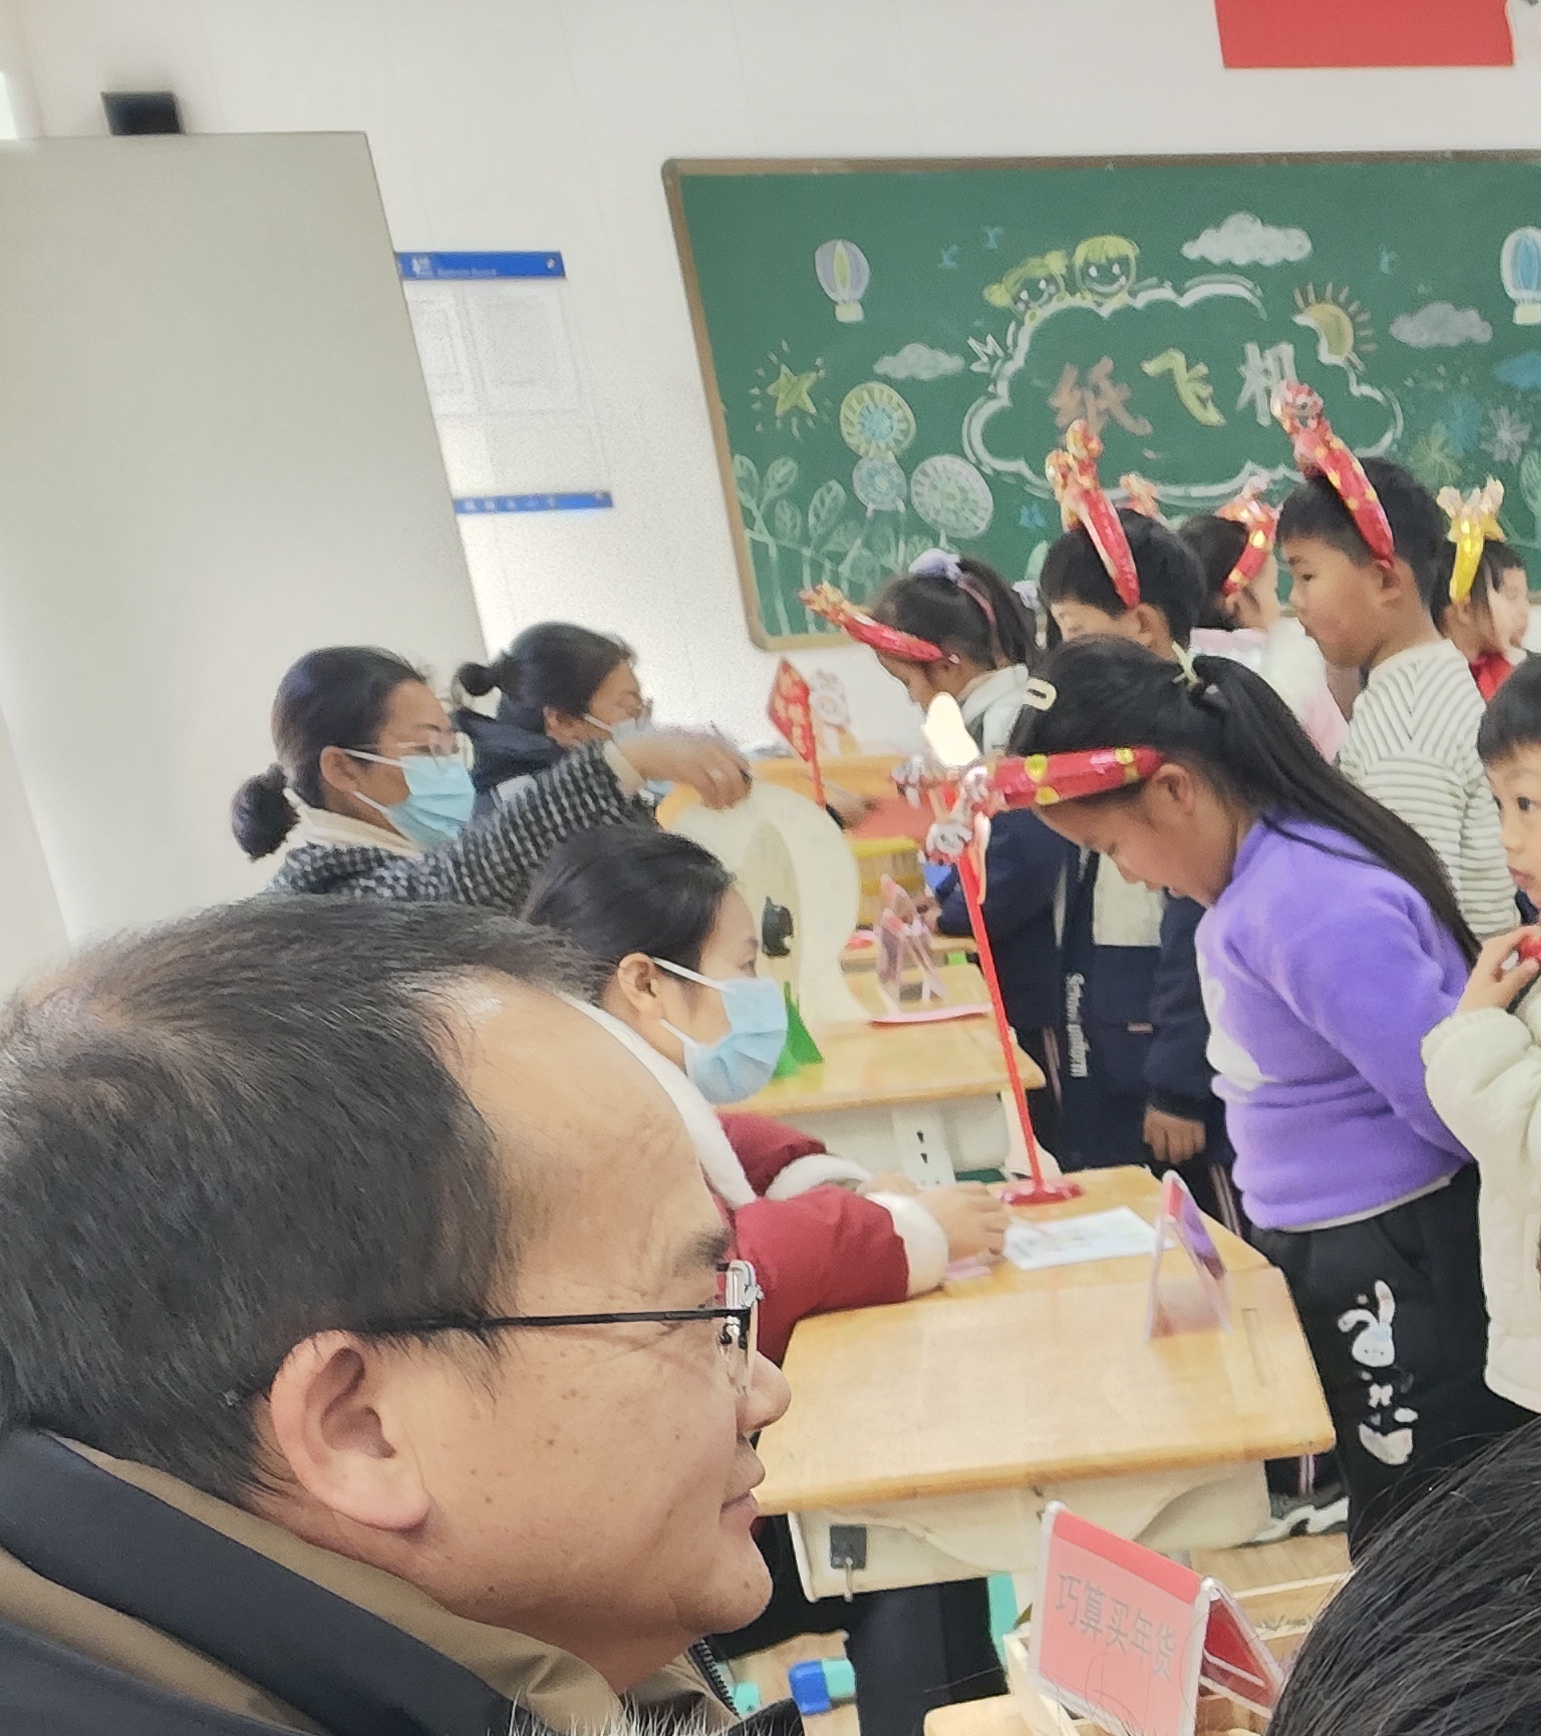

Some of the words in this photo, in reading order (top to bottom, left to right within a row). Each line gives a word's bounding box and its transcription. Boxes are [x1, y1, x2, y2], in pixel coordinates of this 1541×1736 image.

[1055, 1572, 1177, 1683] 巧算买年货
